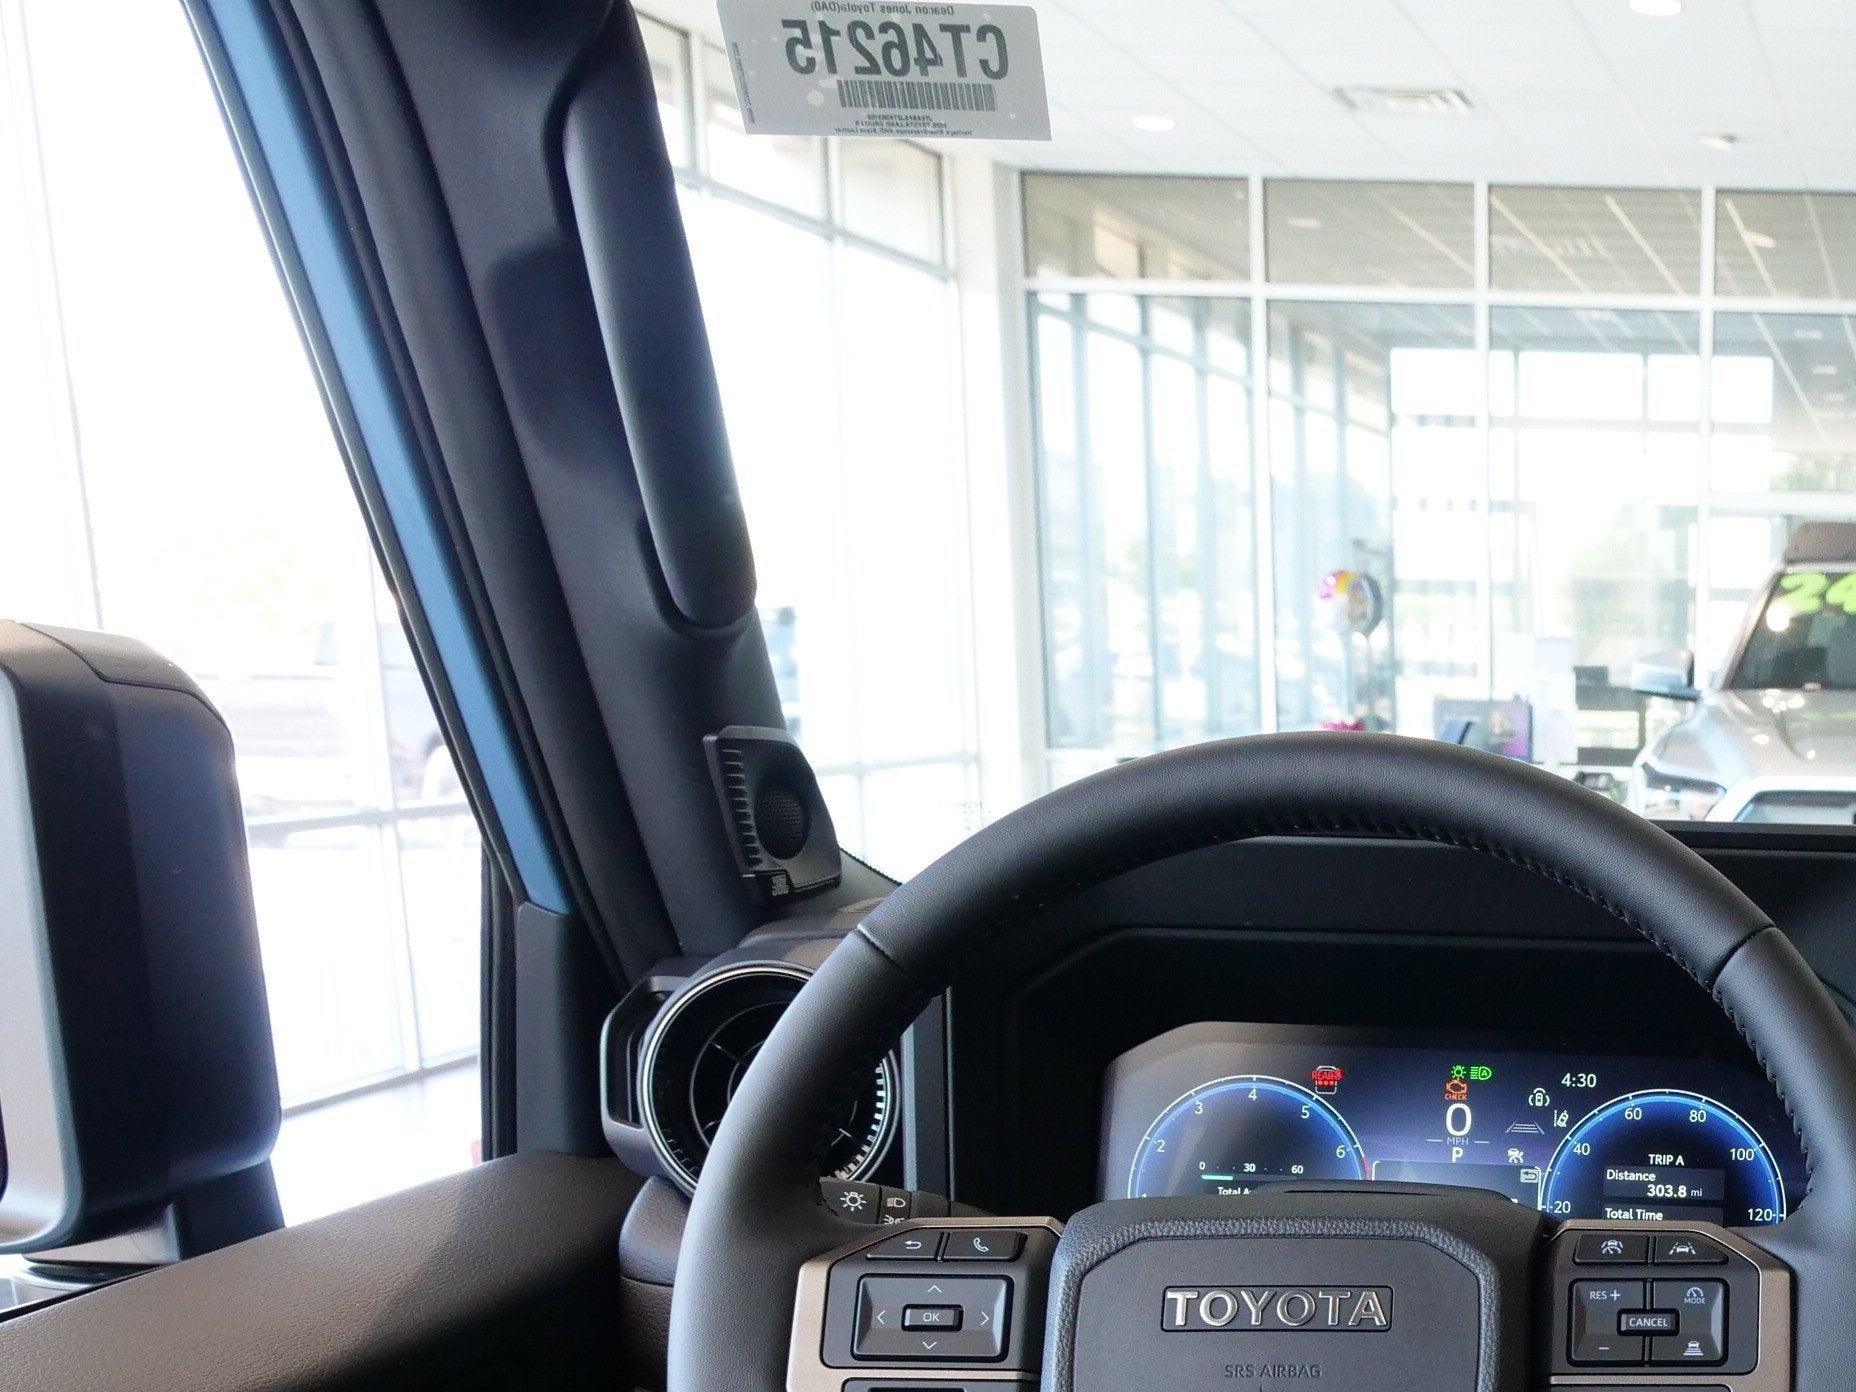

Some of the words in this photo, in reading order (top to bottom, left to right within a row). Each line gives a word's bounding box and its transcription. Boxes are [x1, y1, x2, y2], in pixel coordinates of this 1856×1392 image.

[1561, 1074, 1597, 1088] 4:30
[1248, 1089, 1257, 1101] 4
[1194, 1101, 1203, 1114] 3
[1301, 1105, 1310, 1119] 5
[1625, 1107, 1642, 1120] 60
[1446, 1103, 1472, 1136] 0
[1689, 1110, 1706, 1123] 80
[1156, 1140, 1165, 1152] 2
[1446, 1137, 1469, 1146] MPH
[1336, 1146, 1345, 1158] 6
[1452, 1147, 1463, 1163] P
[1573, 1143, 1590, 1155] 40
[1730, 1148, 1755, 1161] 100
[1648, 1153, 1671, 1165] TRIP
[1673, 1155, 1684, 1166] A
[1199, 1161, 1205, 1171] 0
[1244, 1162, 1256, 1172] 30
[1291, 1164, 1303, 1174] 60
[1606, 1169, 1656, 1182] Distance
[1647, 1184, 1687, 1198] 303.8
[1691, 1188, 1703, 1197] mi
[1554, 1201, 1571, 1214] 20
[1605, 1208, 1633, 1220] Total
[1636, 1208, 1663, 1221] Time
[1747, 1208, 1773, 1221] 120
[1589, 1291, 1607, 1300] RES
[1166, 1290, 1387, 1327] TOYOTA
[923, 1312, 939, 1322] OK
[1629, 1318, 1668, 1327] CANCEL
[1224, 1364, 1255, 1379] SRS
[1259, 1364, 1322, 1379] AIRBAG
